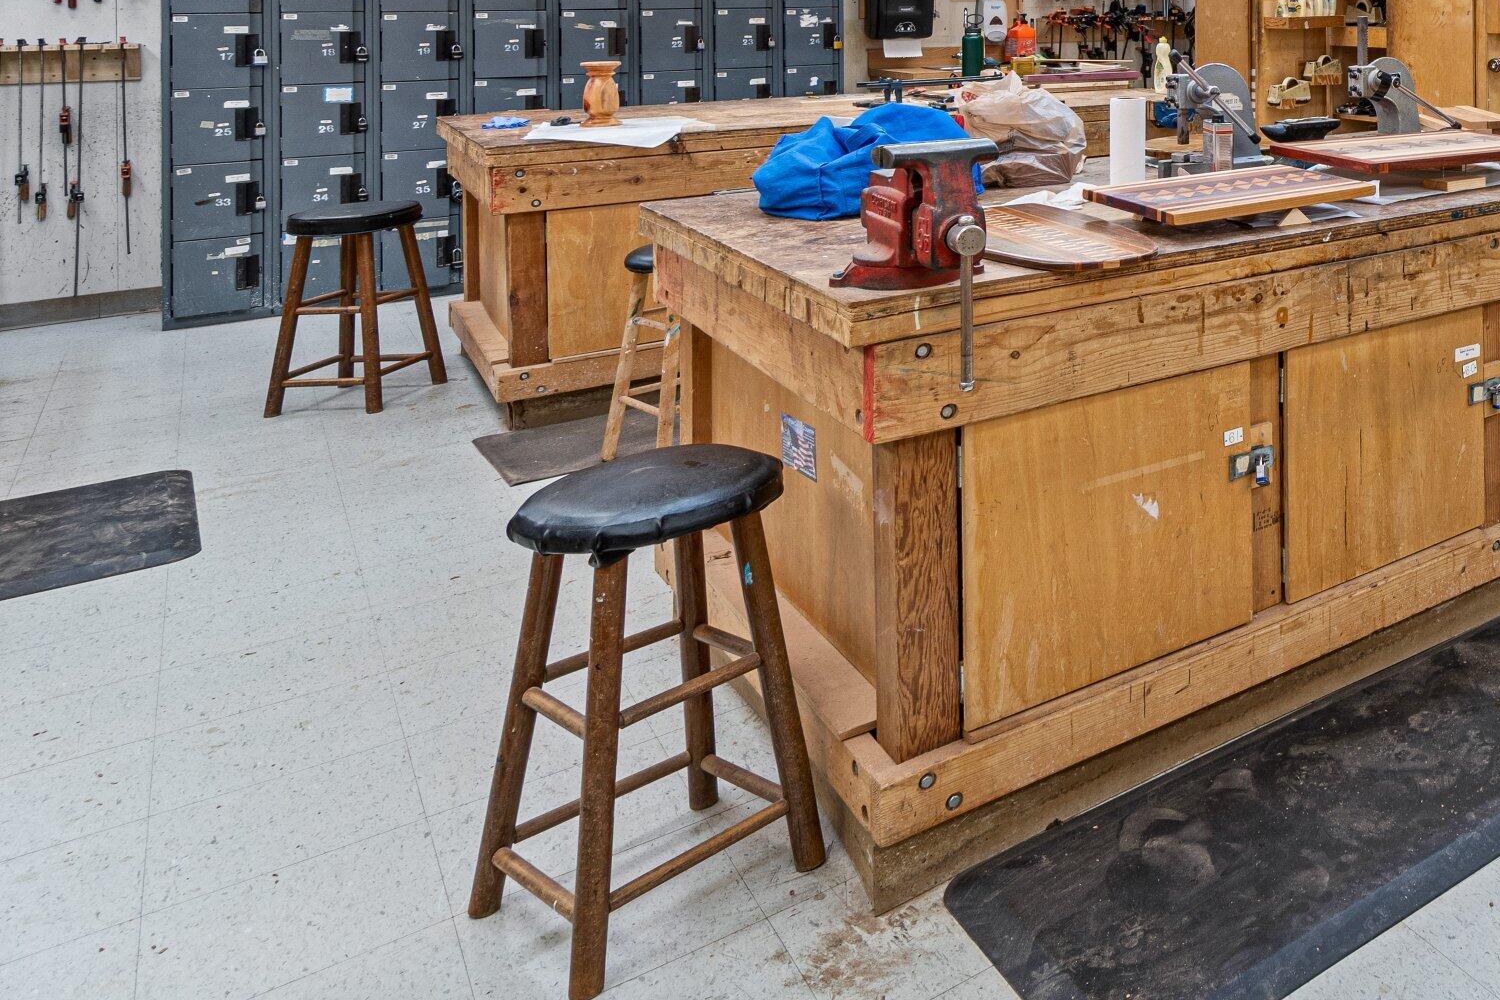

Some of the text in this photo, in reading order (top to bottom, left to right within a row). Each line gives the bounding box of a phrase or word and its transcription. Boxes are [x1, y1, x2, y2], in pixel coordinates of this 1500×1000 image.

[743, 38, 754, 46] 23
[504, 44, 519, 52] 20
[219, 52, 233, 60] 17
[318, 125, 334, 133] 26
[412, 121, 426, 129] 27
[215, 127, 232, 137] 25
[416, 185, 430, 194] 35
[215, 198, 232, 206] 33
[313, 194, 328, 202] 34
